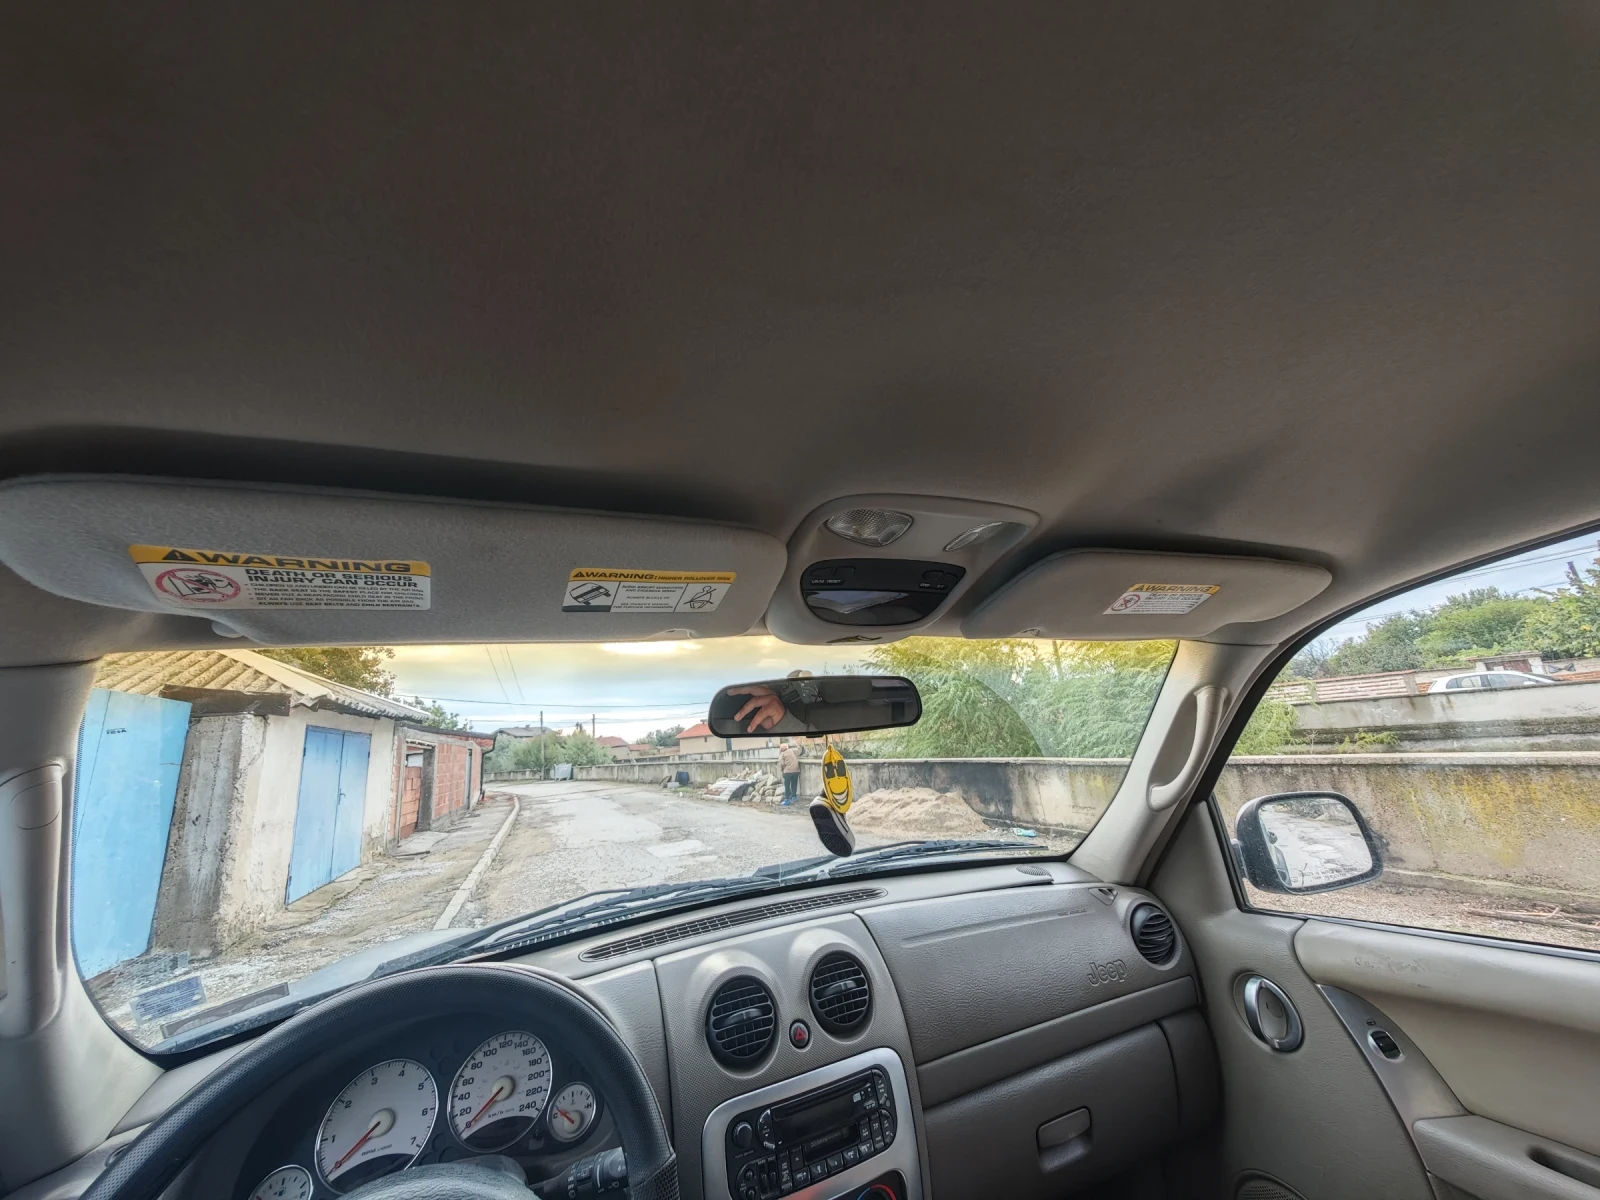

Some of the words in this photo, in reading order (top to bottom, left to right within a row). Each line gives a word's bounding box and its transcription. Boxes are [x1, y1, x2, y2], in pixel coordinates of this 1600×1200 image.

[196, 552, 411, 573] WARNING
[245, 568, 306, 578] DEATH
[342, 574, 412, 582] SERIOUS
[585, 572, 658, 580] WARNING:
[248, 576, 316, 584] INJURY
[1087, 958, 1128, 987] Jeep
[498, 1040, 513, 1048] 120
[514, 1040, 528, 1049] 140
[483, 1048, 497, 1057] 100
[522, 1046, 536, 1056] 160
[470, 1061, 482, 1070] 80
[528, 1058, 542, 1066] 180
[528, 1070, 545, 1081] 200
[462, 1077, 474, 1086] 60
[526, 1086, 543, 1096] 220
[458, 1092, 470, 1101] 40
[344, 1100, 352, 1108] 2
[519, 1100, 536, 1112] 240
[422, 1108, 428, 1116] 6
[460, 1107, 472, 1116] 20
[331, 1135, 336, 1143] 1
[410, 1136, 417, 1145] 7
[362, 1148, 376, 1156] RPM
